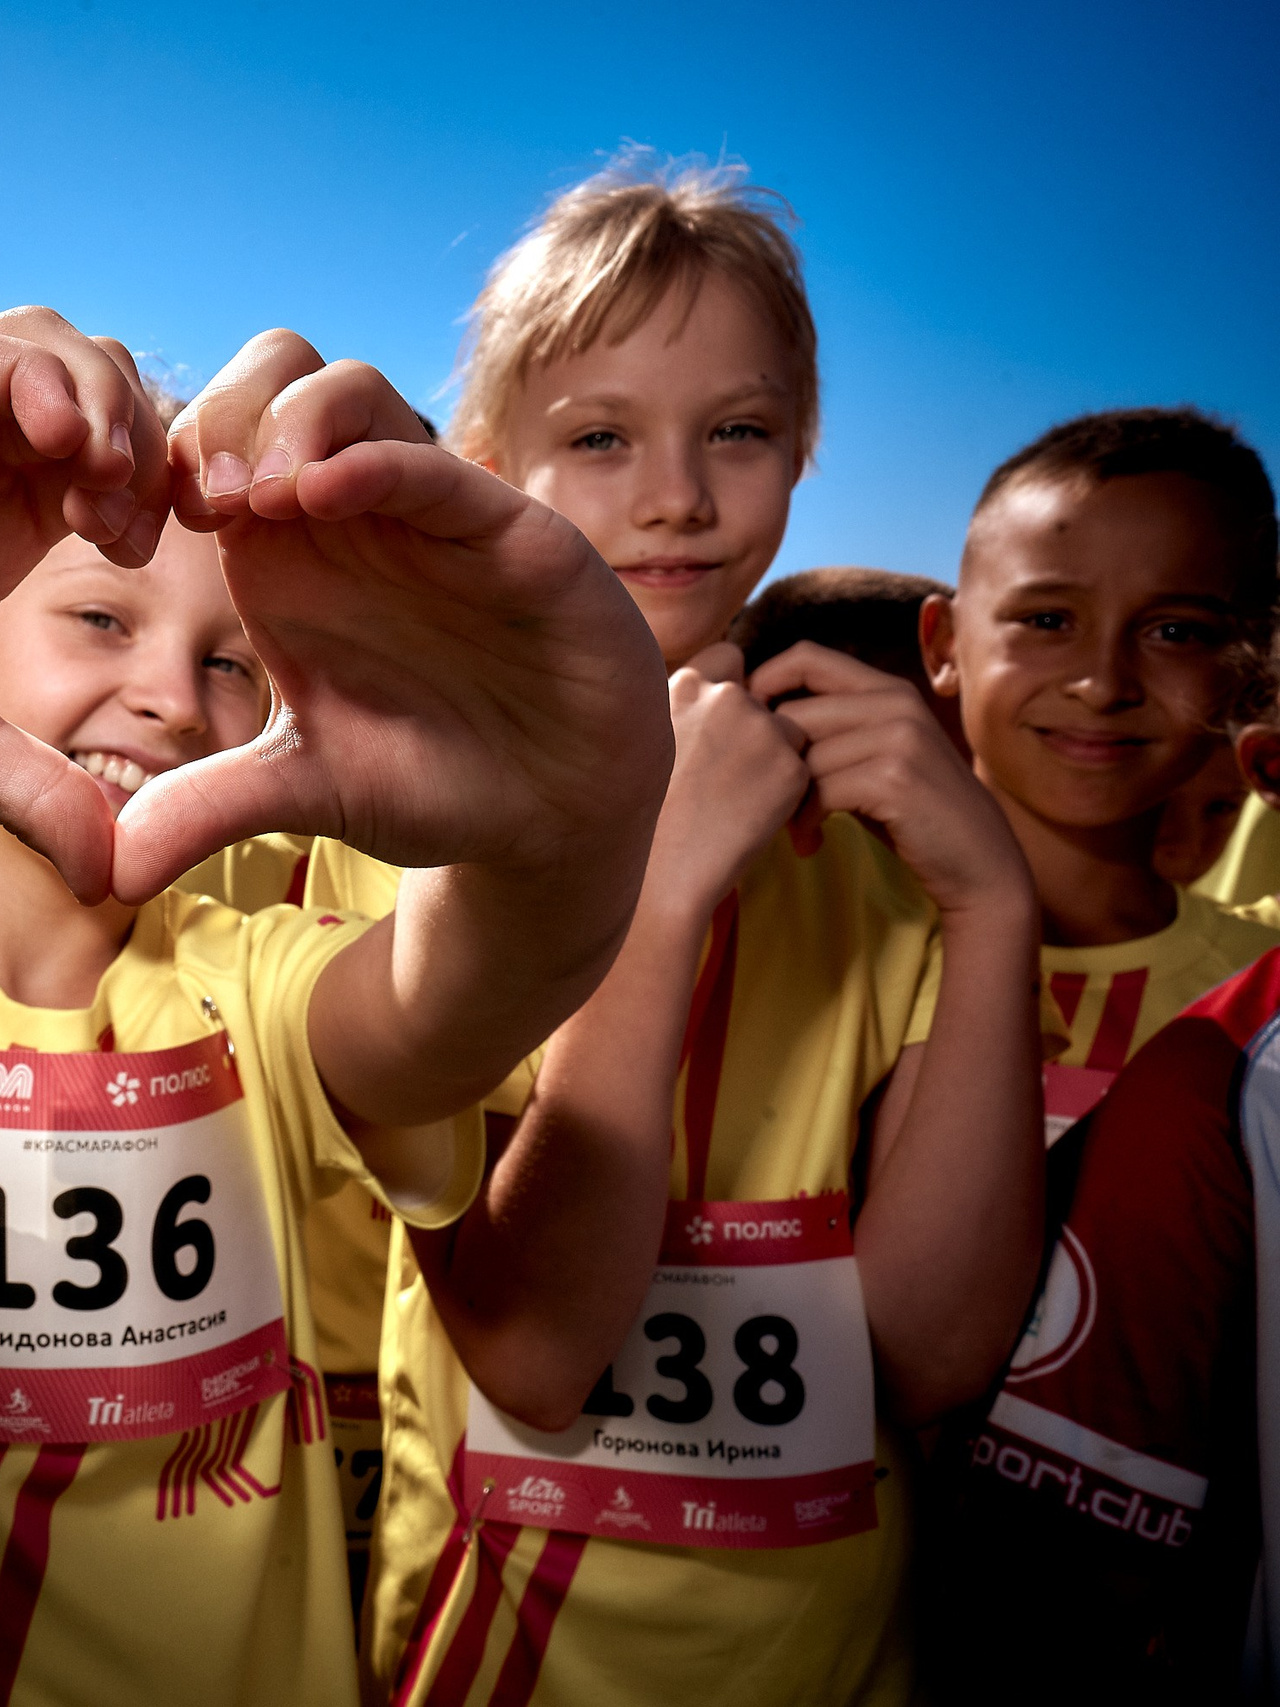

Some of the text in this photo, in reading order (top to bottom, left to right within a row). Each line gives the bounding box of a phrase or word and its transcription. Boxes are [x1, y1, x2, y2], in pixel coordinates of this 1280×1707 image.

[150, 1064, 213, 1098] ПОЛЮС
[23, 1137, 159, 1154] #КРАСМАРАФОН
[723, 1218, 803, 1241] ПОЛЮС
[653, 1270, 736, 1287] СМАРАФОН
[121, 1309, 227, 1347] Анастасия
[593, 1429, 781, 1465] Горюнова Ирина
[969, 1434, 1193, 1547] port.club
[508, 1497, 565, 1518] SPORT
